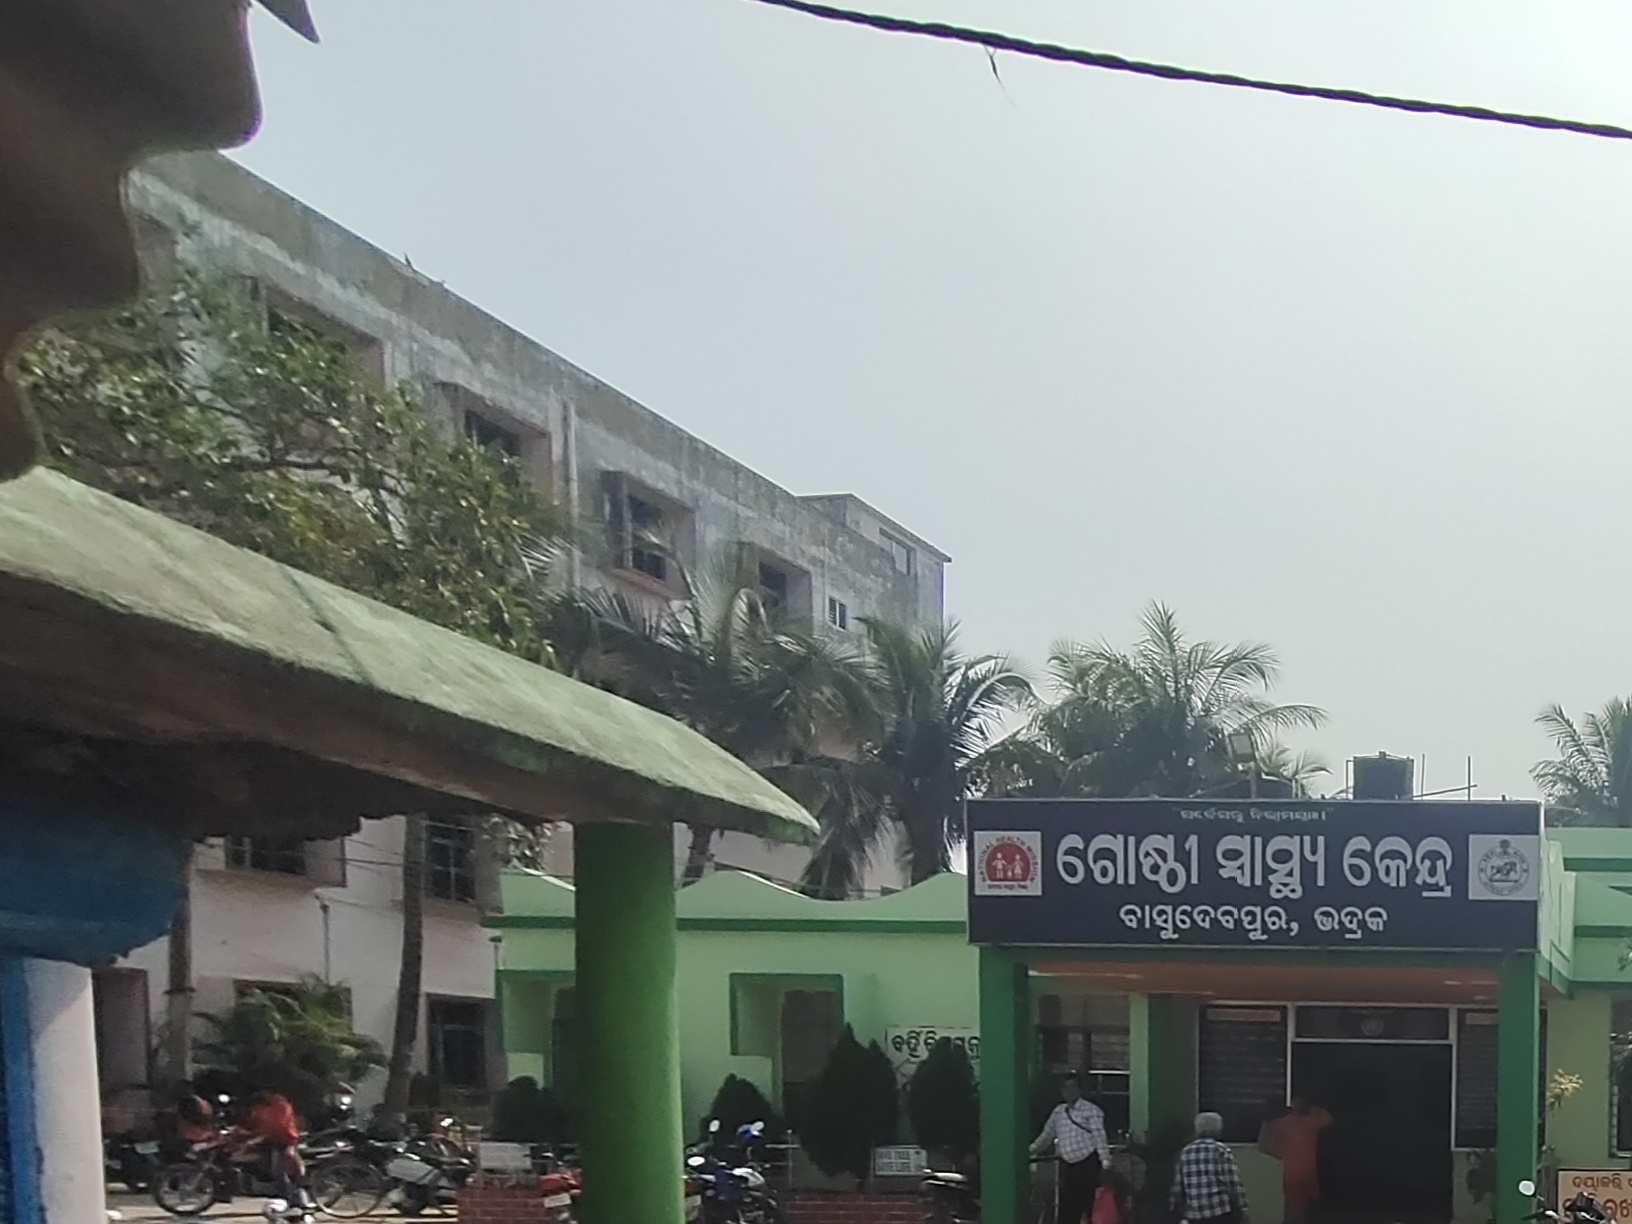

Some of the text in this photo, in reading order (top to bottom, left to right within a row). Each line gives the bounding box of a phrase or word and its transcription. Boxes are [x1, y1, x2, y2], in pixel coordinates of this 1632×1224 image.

[1056, 833, 1200, 894] ଗୋଷ୍ଠୀ
[1342, 835, 1453, 898] କେନ୍ଦ୍ର
[1119, 904, 1388, 940] ବାସୁଦେବପୁର, ଭଦ୍ରକ
[1571, 1173, 1624, 1191] ଦୟାକରି
